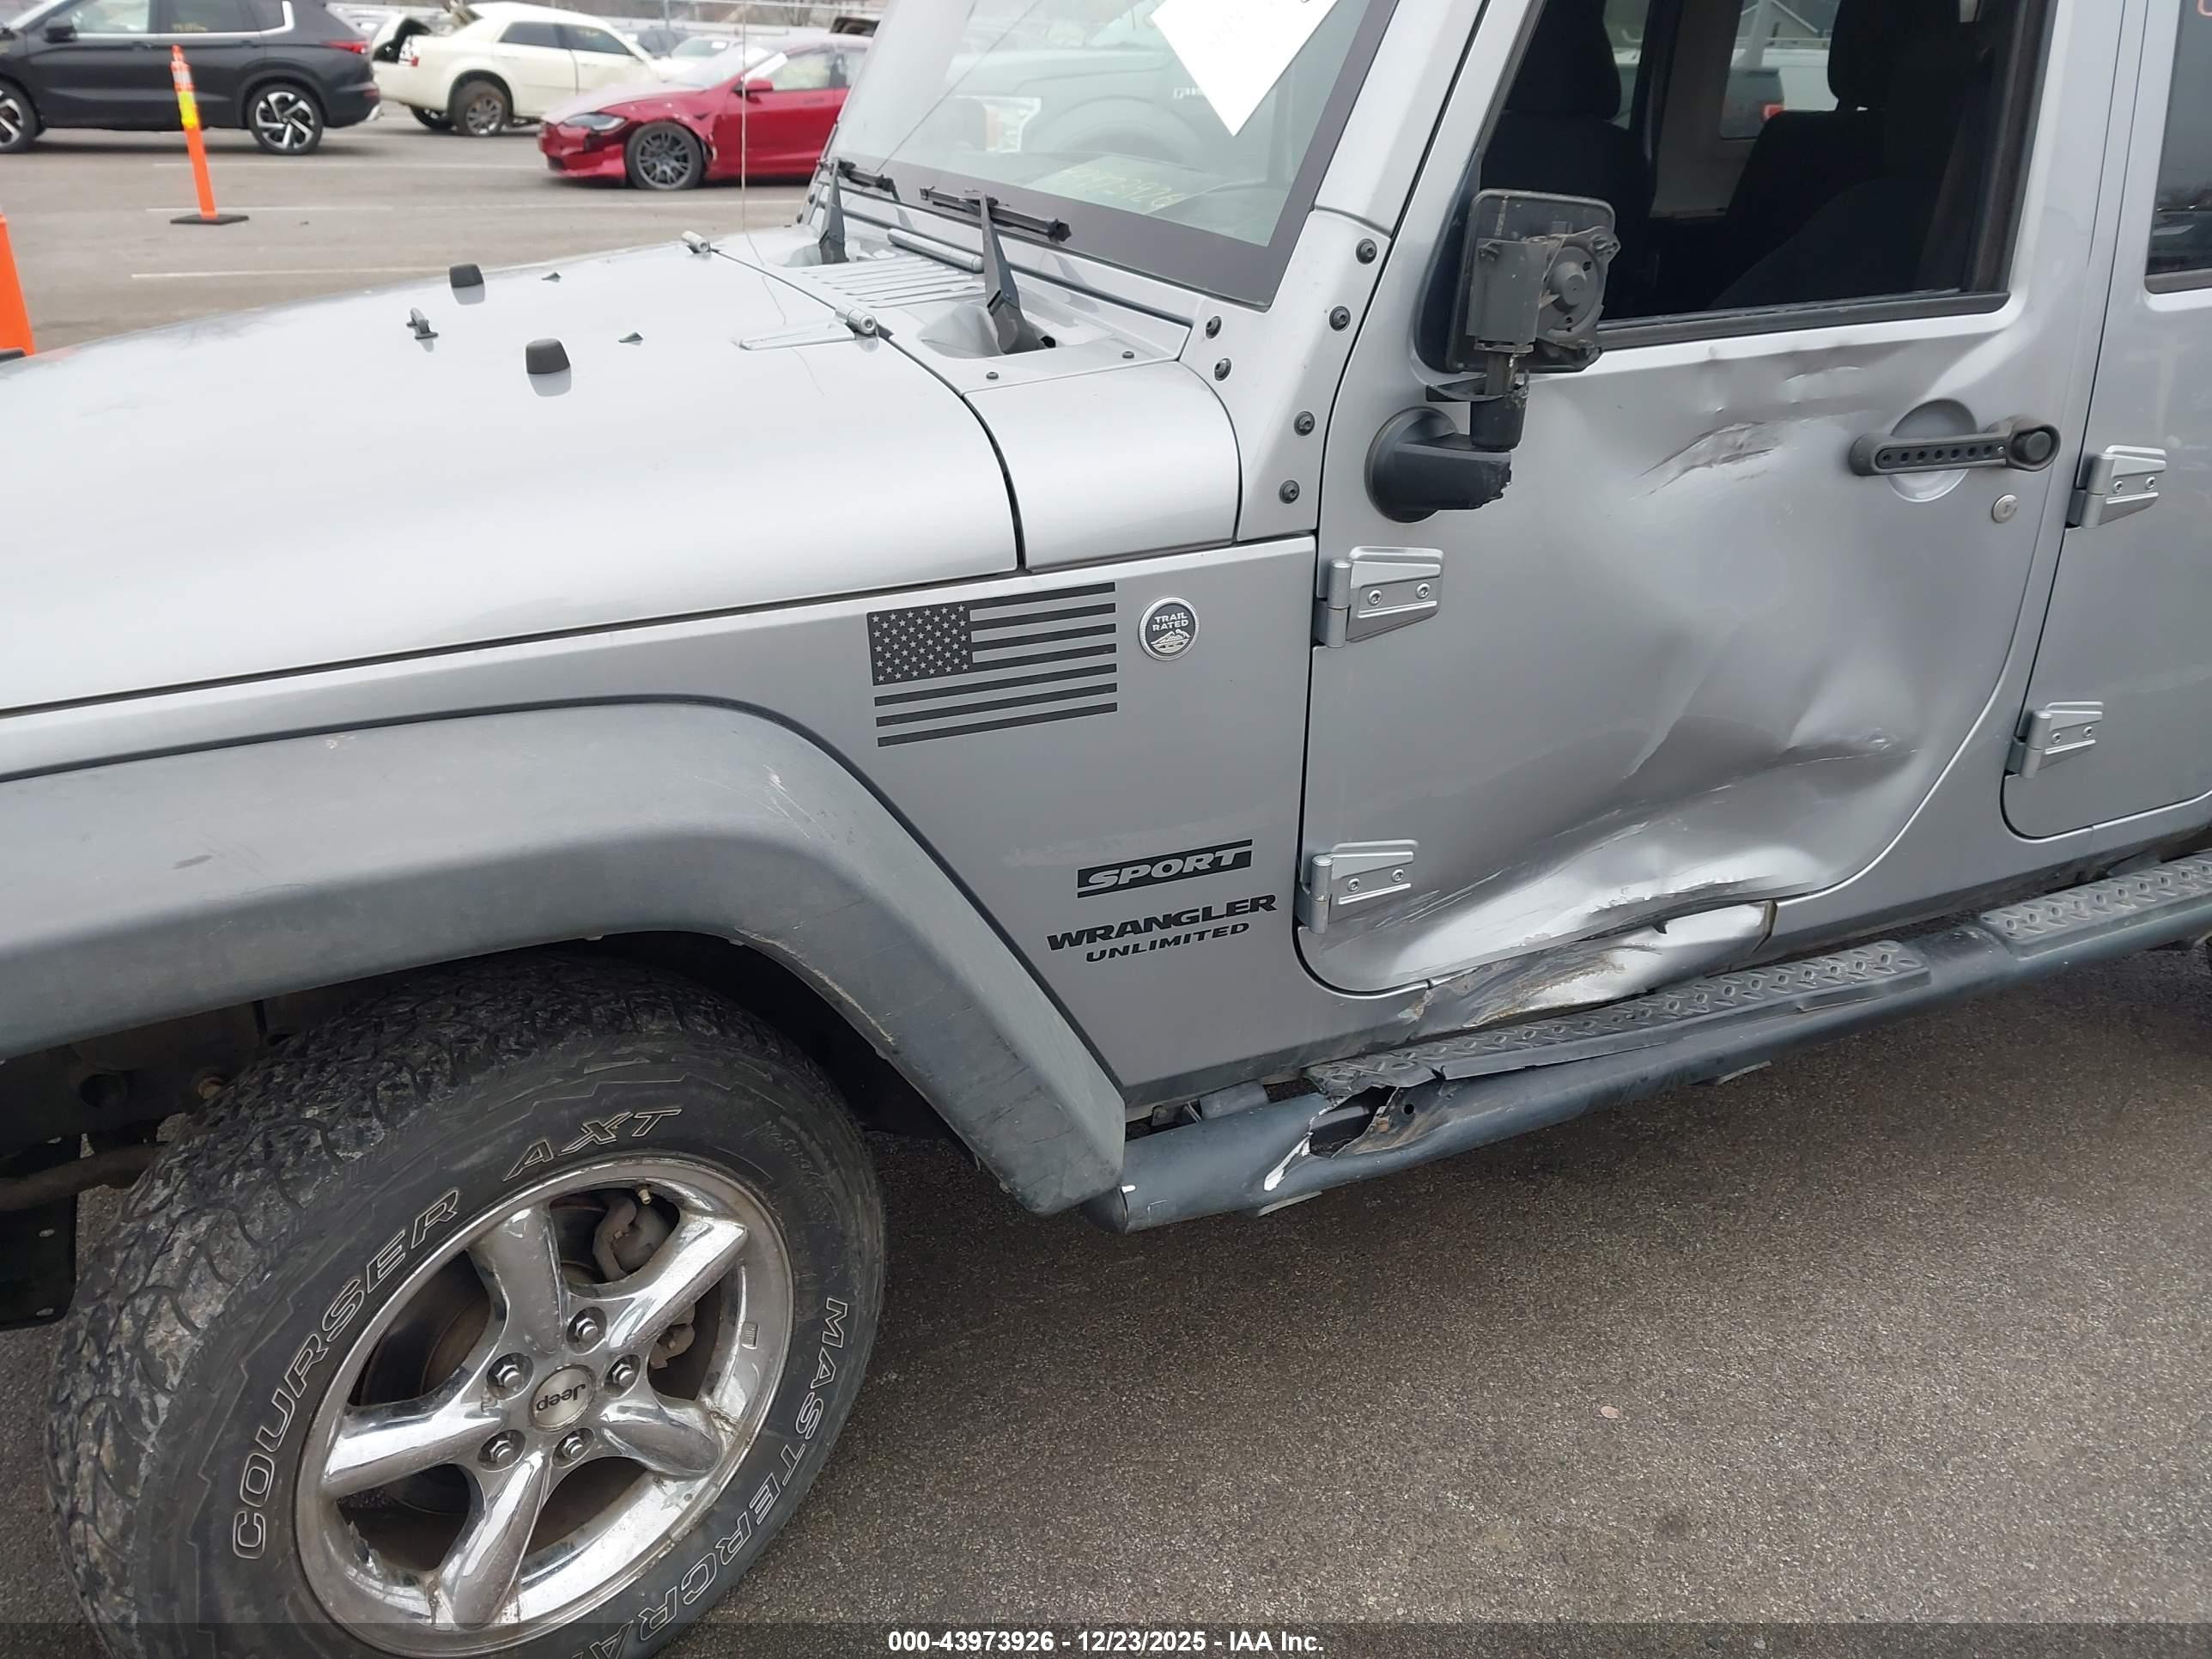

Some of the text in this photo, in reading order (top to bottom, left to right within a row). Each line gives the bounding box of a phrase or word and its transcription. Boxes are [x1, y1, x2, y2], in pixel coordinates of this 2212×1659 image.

[1152, 619, 1189, 632] RATED
[1153, 611, 1188, 623] TRAIL
[1084, 848, 1247, 889] SPORT
[1046, 894, 1279, 951] WRANGLER
[1085, 922, 1250, 963] UNLIMITED
[232, 1108, 684, 1559] COURSER AXT
[536, 1383, 586, 1412] Jeep
[570, 1297, 849, 1659] MASTERCRA
